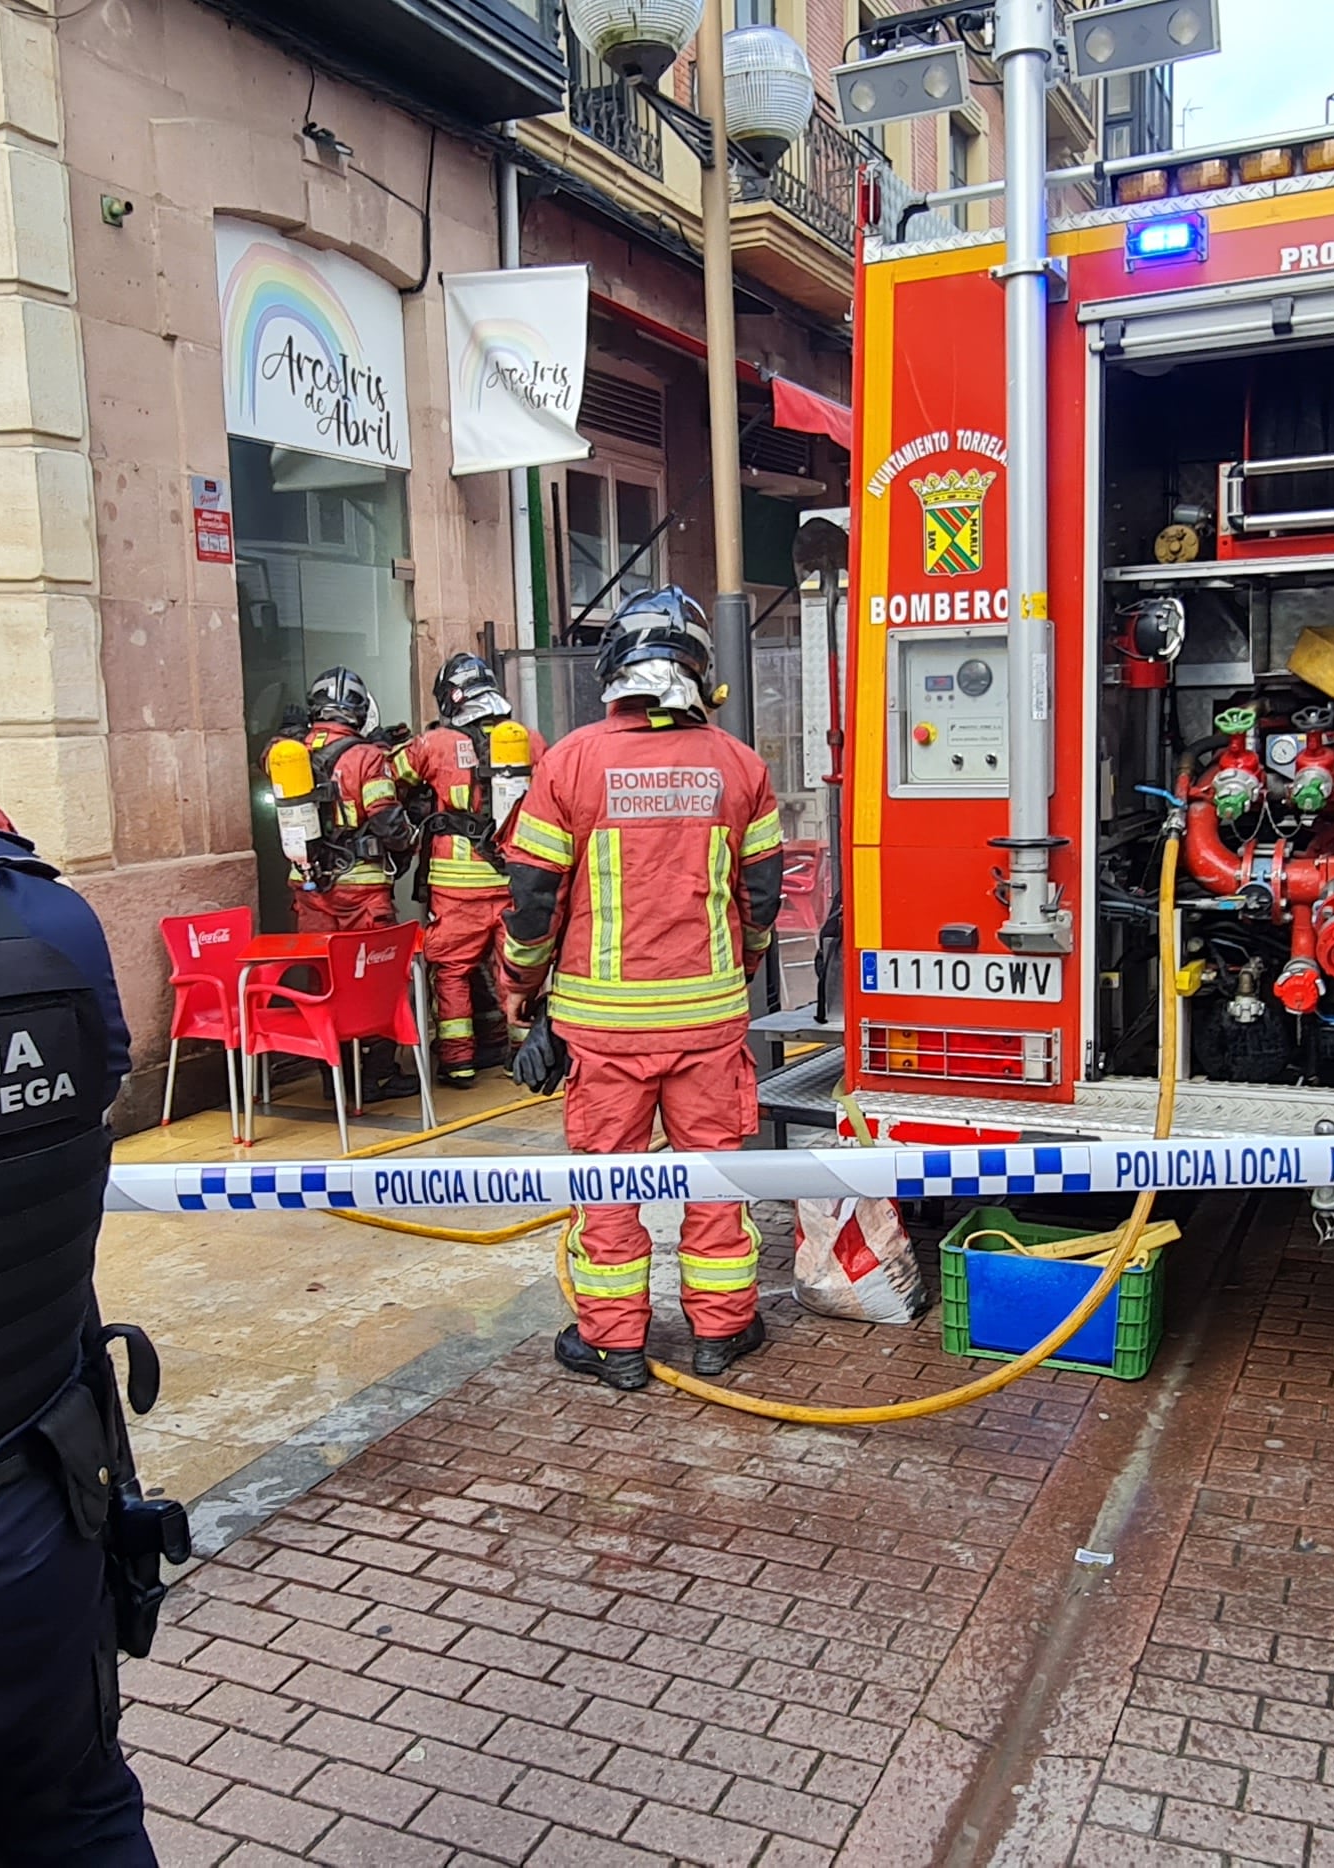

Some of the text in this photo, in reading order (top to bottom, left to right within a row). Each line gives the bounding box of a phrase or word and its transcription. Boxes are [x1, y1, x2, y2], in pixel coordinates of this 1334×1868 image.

[305, 386, 399, 461] de Abril
[867, 429, 1009, 500] AYUNTAMIENTO TORRELA
[927, 530, 937, 551] AVE
[969, 518, 979, 557] MARIA
[870, 588, 1009, 625] BOMBERO
[609, 771, 721, 789] BOMBEROS
[866, 957, 1052, 996] E 1110 GWV
[375, 1164, 690, 1205] POLICIA LOCAL NO PASAR
[1116, 1149, 1217, 1188] POLICIA
[1225, 1147, 1307, 1186] LOCAL
